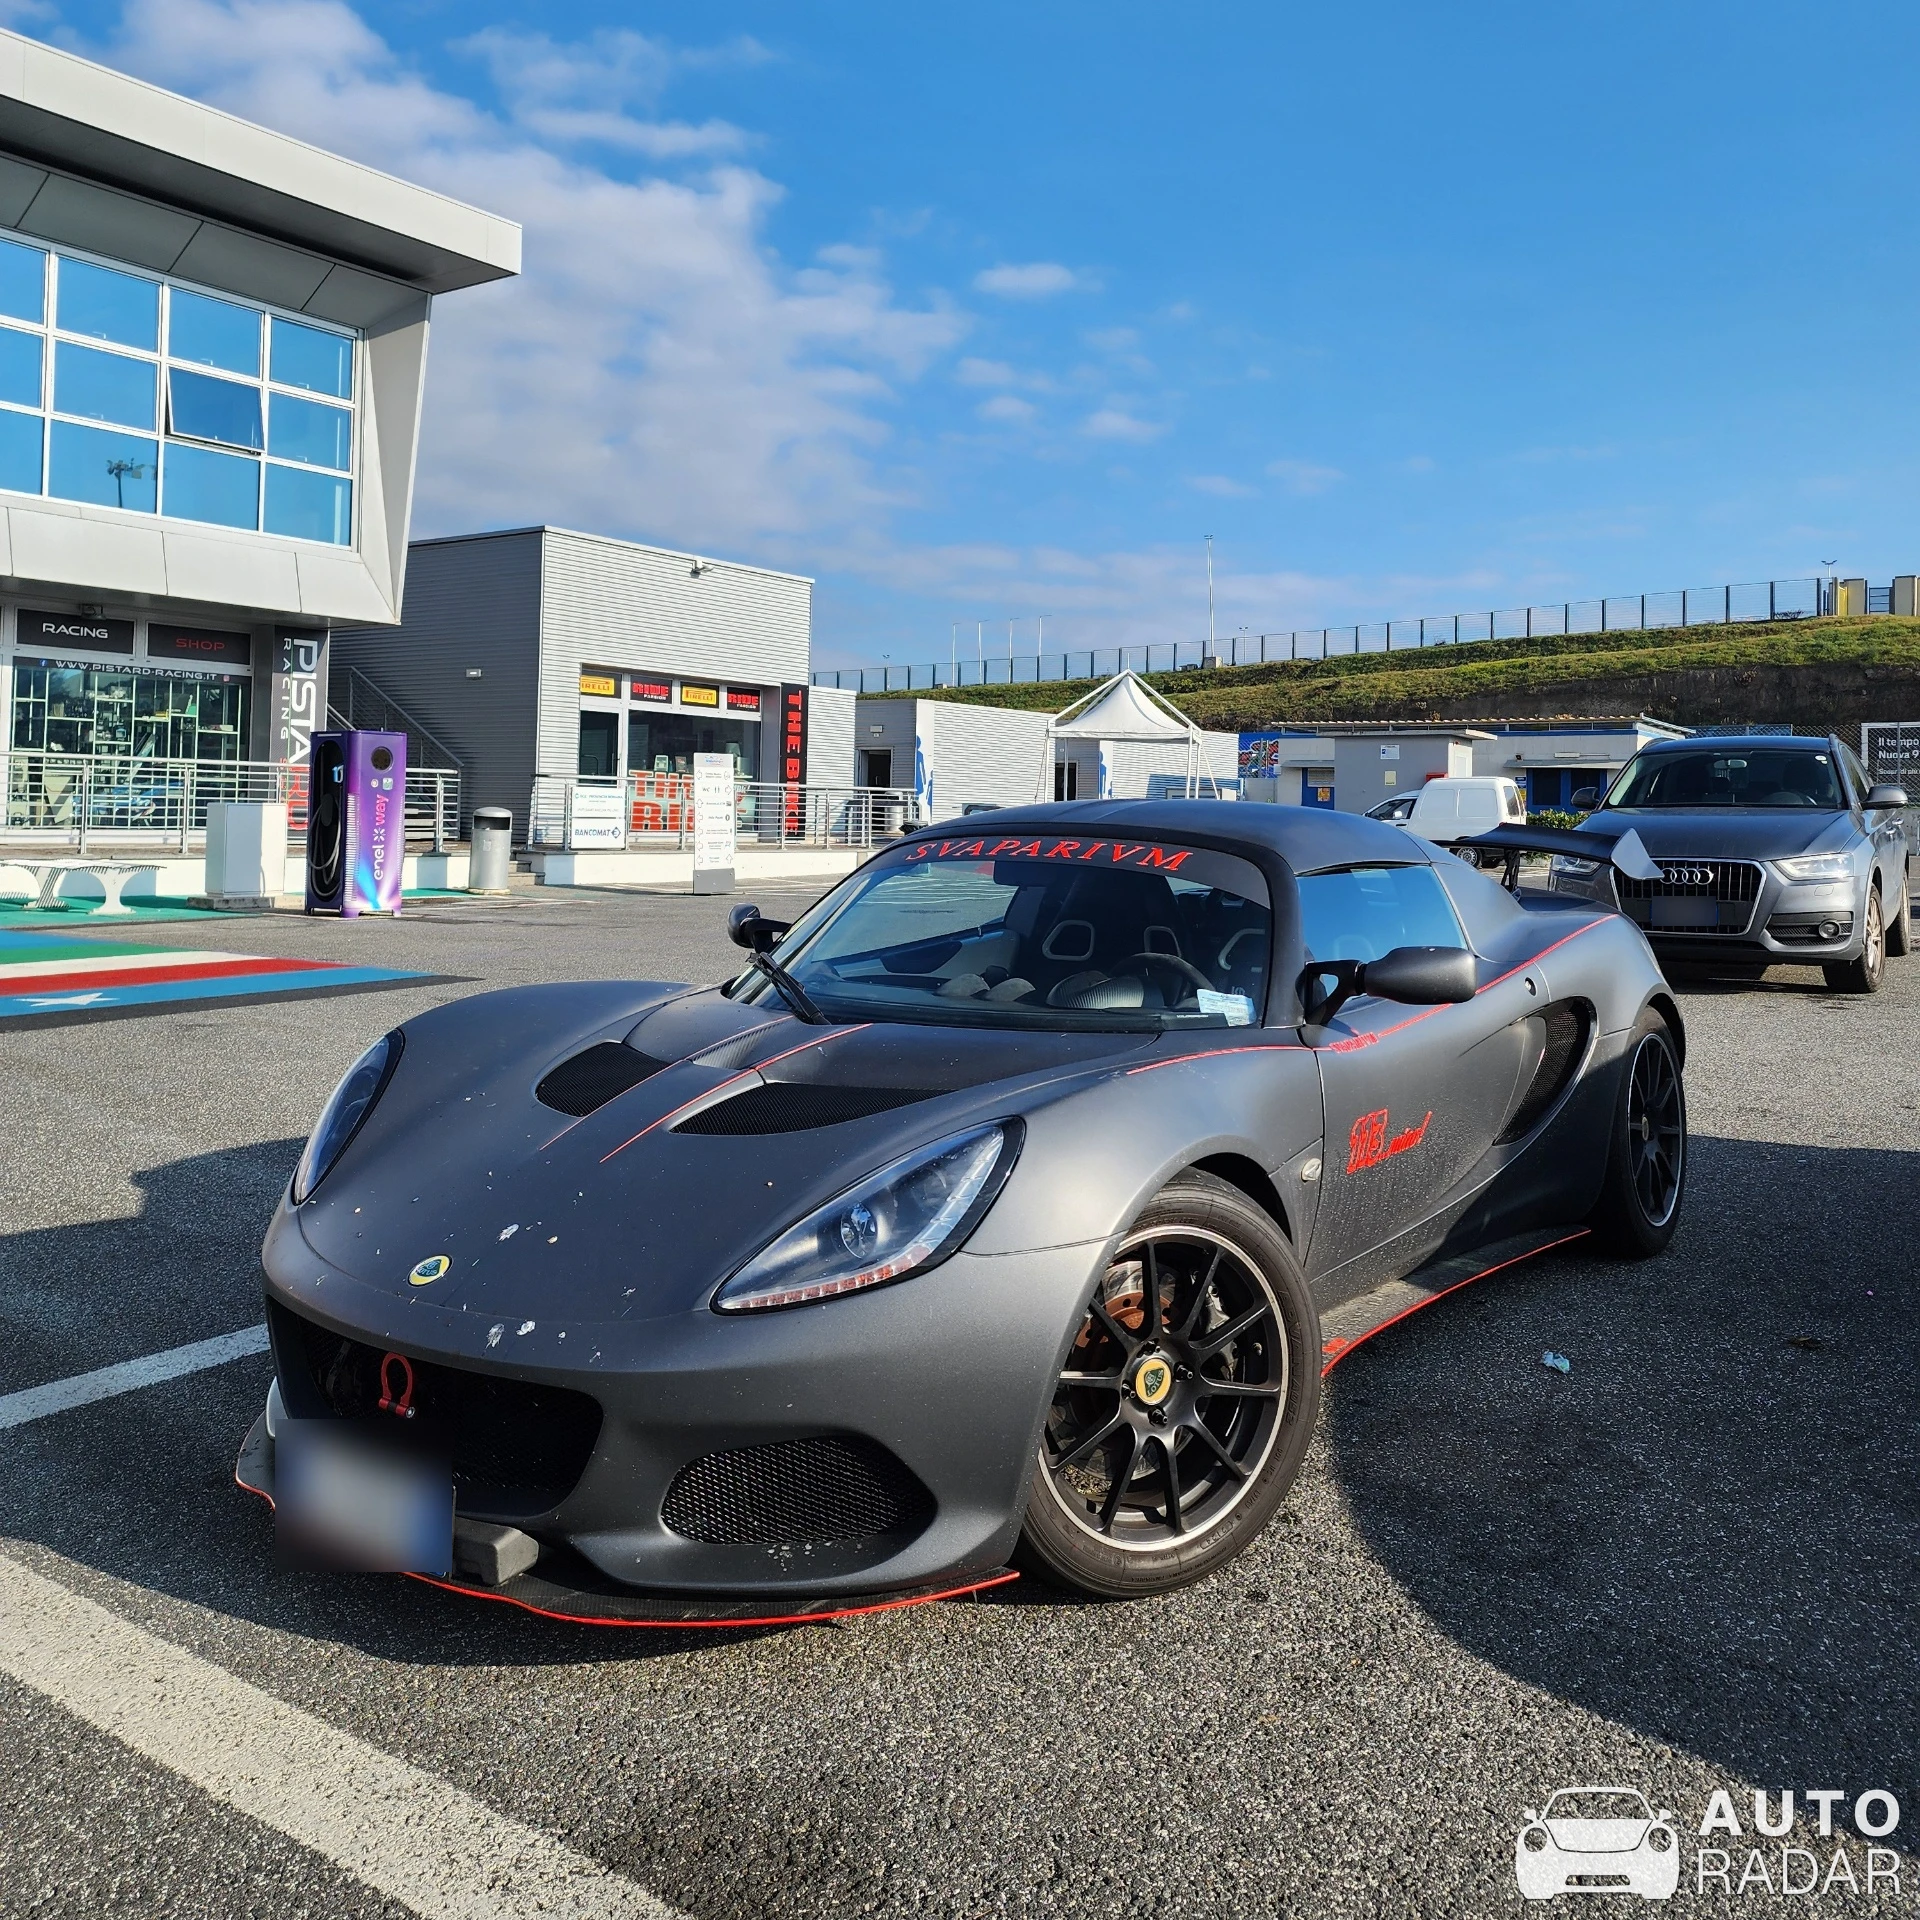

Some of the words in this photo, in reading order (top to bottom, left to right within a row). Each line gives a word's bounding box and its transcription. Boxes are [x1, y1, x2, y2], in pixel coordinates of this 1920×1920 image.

[42, 622, 109, 639] RACING
[175, 638, 226, 651] SHOP
[280, 637, 292, 740] RACING
[632, 682, 669, 697] RIDE
[685, 689, 713, 702] PIRELLI
[727, 693, 759, 706] RIDE
[786, 690, 802, 754] THE
[1878, 737, 1885, 746] Il
[1878, 750, 1910, 759] Nuova
[785, 758, 800, 836] BIKE
[375, 793, 389, 826] way
[574, 828, 611, 837] BANCOMAT
[372, 844, 385, 881] enel
[905, 840, 1194, 871] SVAPARIVM
[1147, 1369, 1164, 1396] LOTUS
